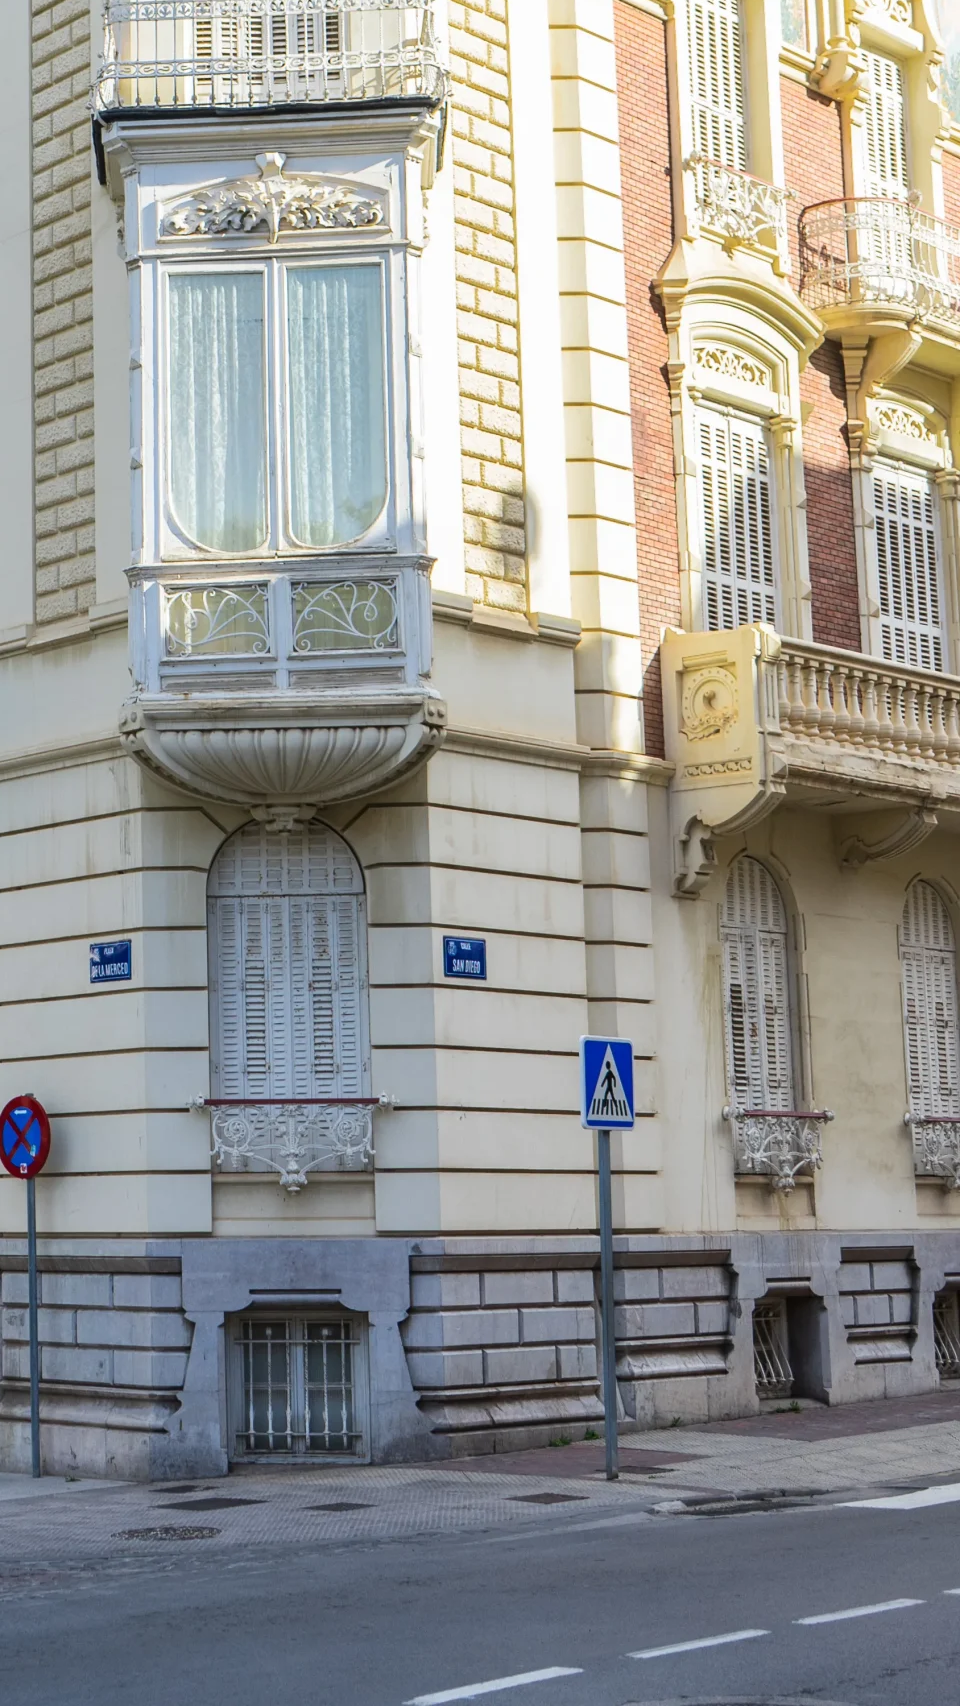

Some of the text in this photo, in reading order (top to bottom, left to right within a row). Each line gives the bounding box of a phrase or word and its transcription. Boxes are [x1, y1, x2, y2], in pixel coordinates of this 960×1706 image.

[91, 962, 128, 978] DE LA MERCED
[452, 958, 480, 974] SAN DIEGO
